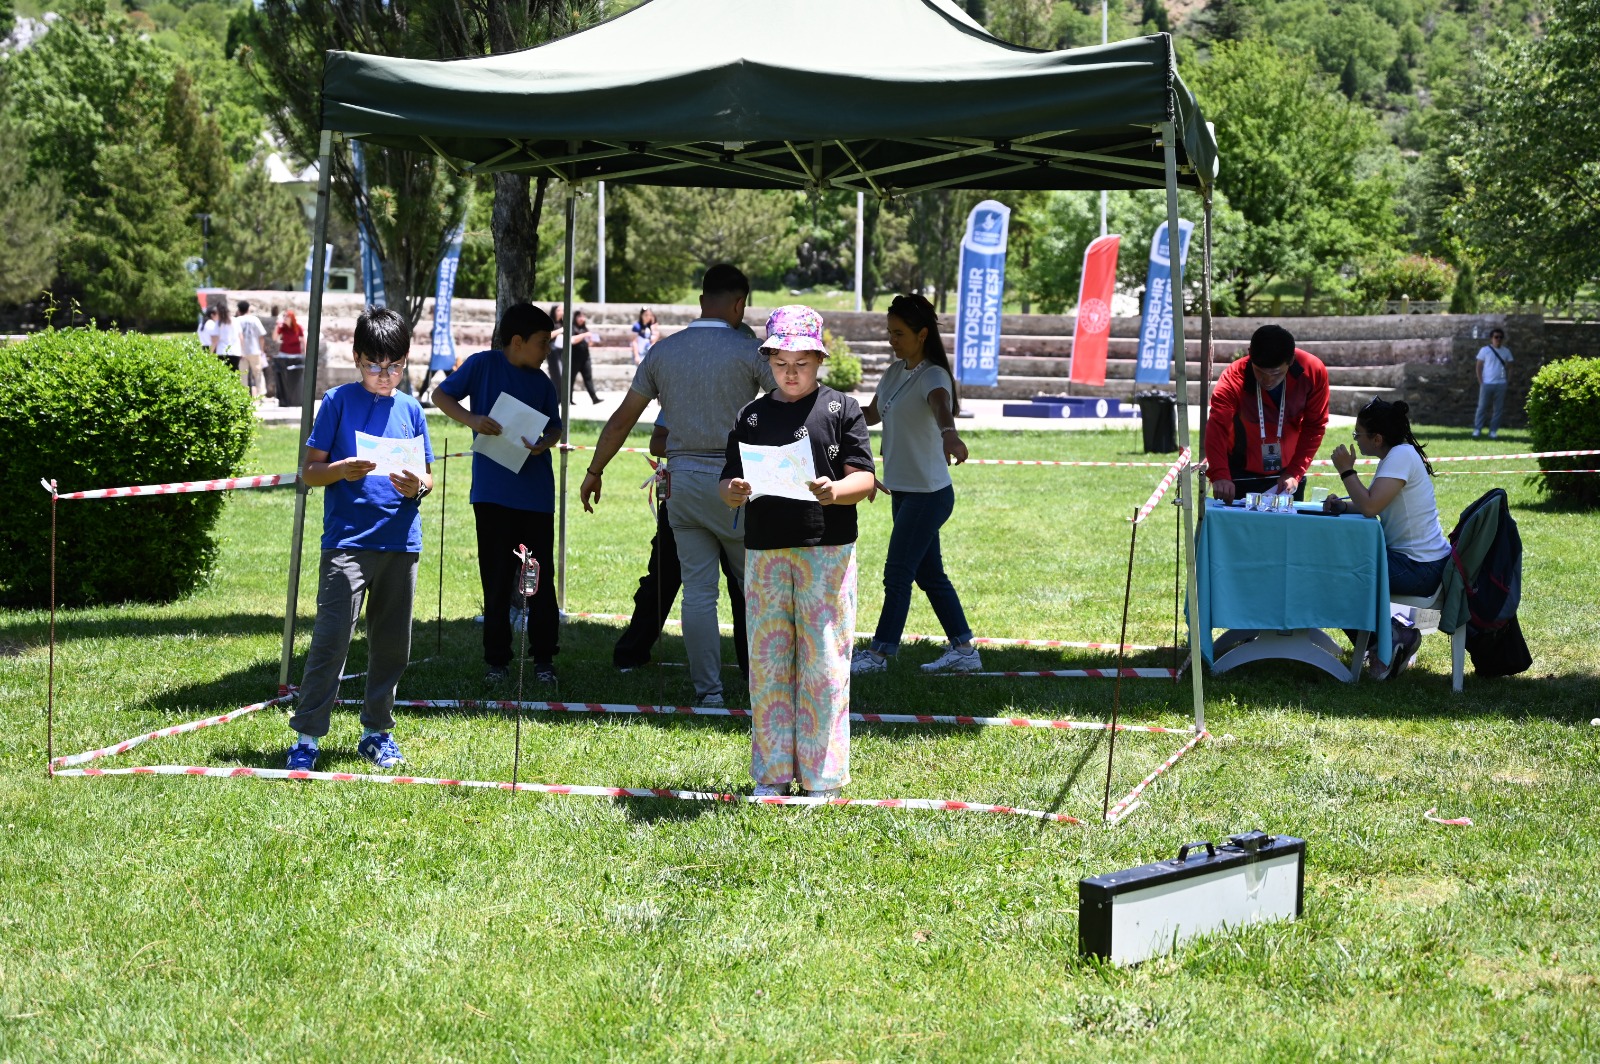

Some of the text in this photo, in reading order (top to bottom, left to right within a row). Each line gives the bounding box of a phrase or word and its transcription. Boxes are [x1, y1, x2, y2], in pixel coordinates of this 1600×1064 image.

[962, 267, 984, 369] SEYDİŞEHİR
[980, 268, 1000, 370] BELEDİYESİ
[1141, 277, 1165, 369] SEYDİŞEHİR
